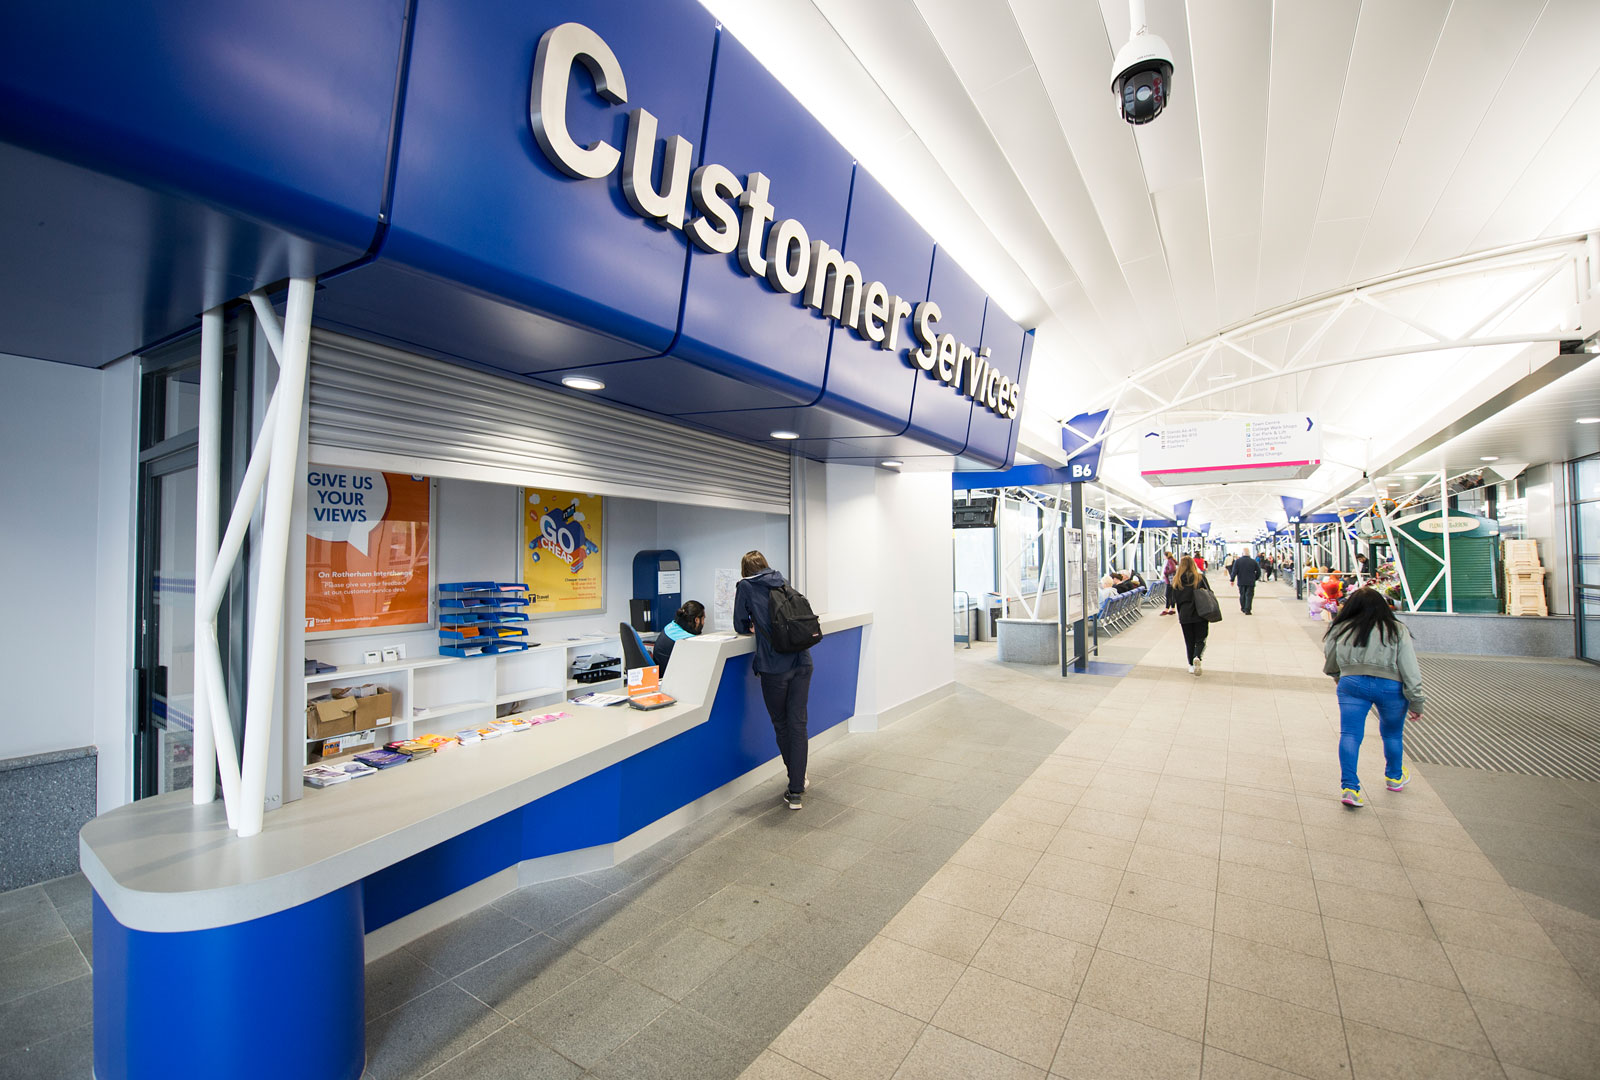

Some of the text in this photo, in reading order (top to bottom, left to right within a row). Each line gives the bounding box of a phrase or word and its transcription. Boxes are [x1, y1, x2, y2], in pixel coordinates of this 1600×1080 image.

[530, 21, 1020, 420] Customer Services
[1072, 464, 1092, 478] B6
[307, 472, 373, 490] GIVE US
[317, 490, 364, 506] YOUR
[313, 507, 367, 522] VIEWS
[540, 515, 575, 554] GO
[541, 537, 573, 564] CHEAP
[332, 570, 372, 578] Rotherham
[373, 569, 412, 578] Interchange
[345, 581, 359, 589] give
